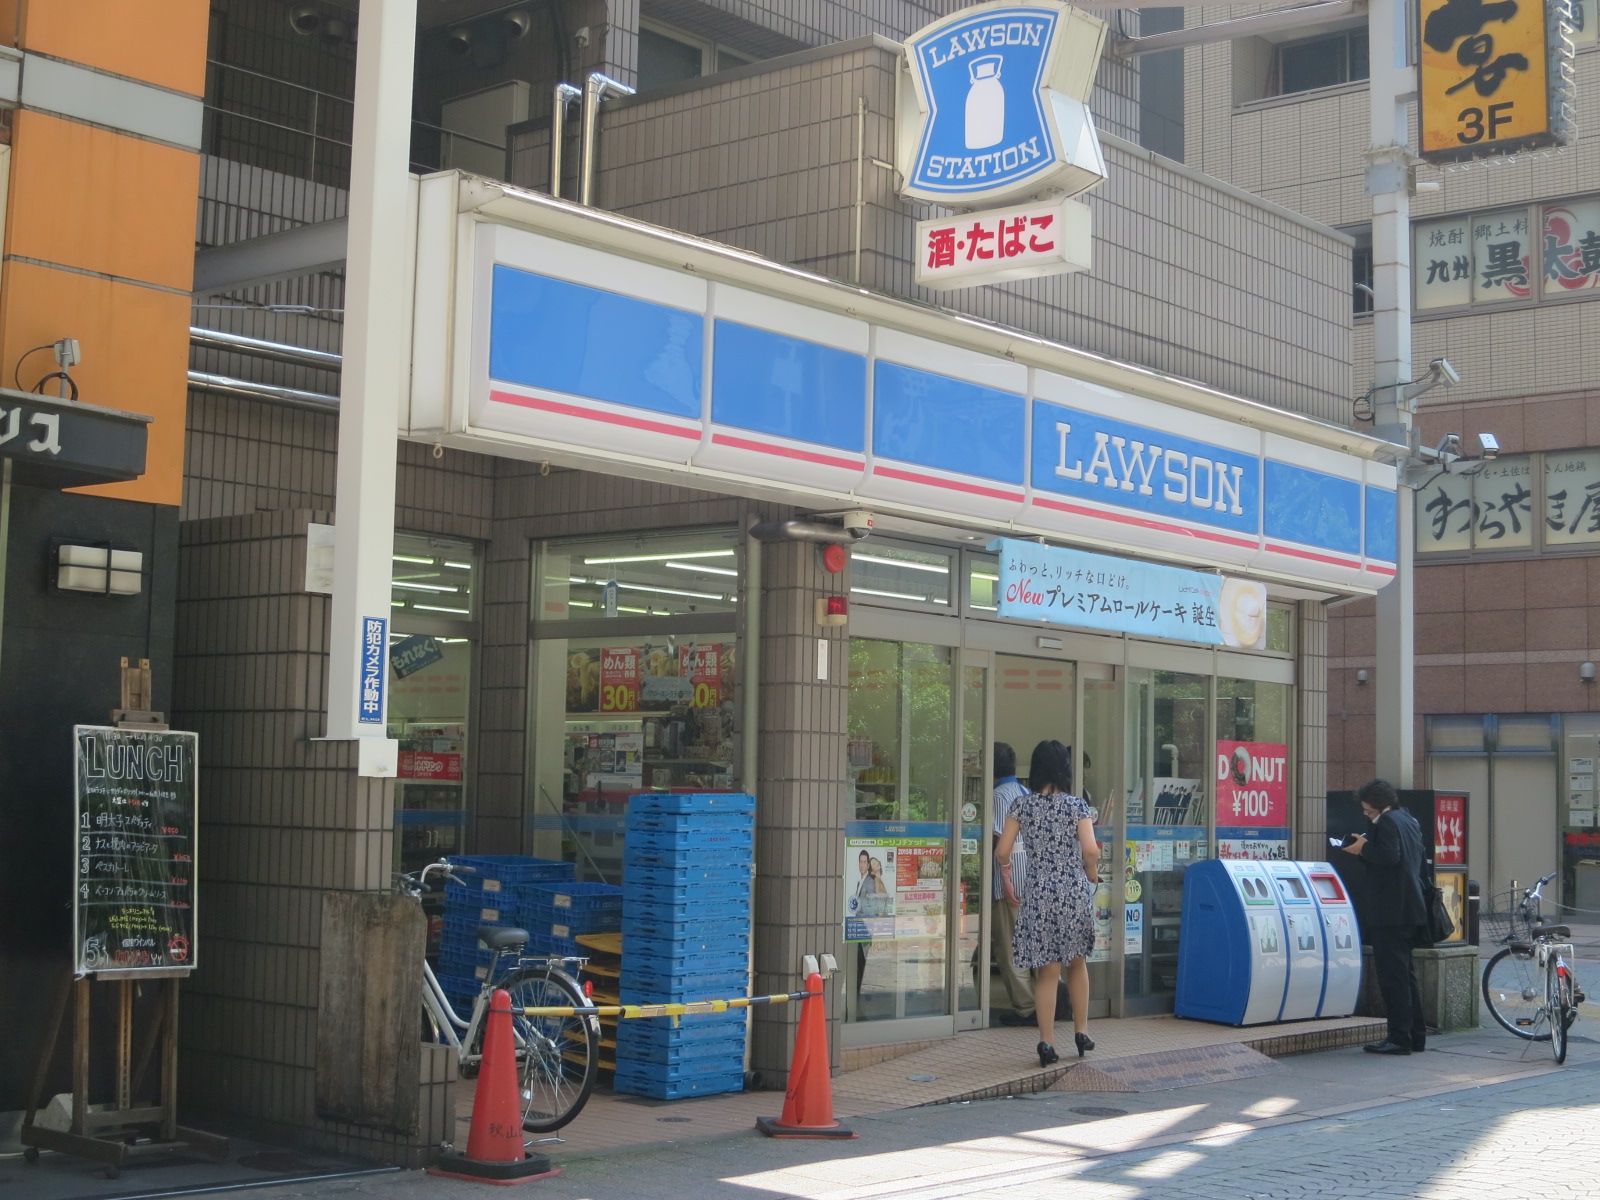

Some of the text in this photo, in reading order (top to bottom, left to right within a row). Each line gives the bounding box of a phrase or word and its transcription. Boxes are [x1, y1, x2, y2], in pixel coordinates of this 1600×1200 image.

[929, 22, 1044, 69] LAWSON
[1456, 101, 1514, 144] 3F
[926, 136, 1041, 180] STATION
[927, 213, 1055, 269] 酒・たばこ
[1055, 421, 1244, 516] LAWSON
[1009, 557, 1130, 590] ふわっと、リッチな口どけ。
[1006, 578, 1044, 606] New
[1046, 586, 1188, 622] プレミアムロールケーキ
[1192, 602, 1217, 627] 誕生
[363, 620, 382, 714] 防犯カメラ作動中
[603, 655, 636, 670] めん類
[86, 736, 183, 782] LUNCH
[81, 812, 91, 829] 1
[1232, 790, 1268, 817] ¥100
[82, 836, 91, 851] 2
[81, 858, 90, 873] 3
[80, 883, 90, 899] 4
